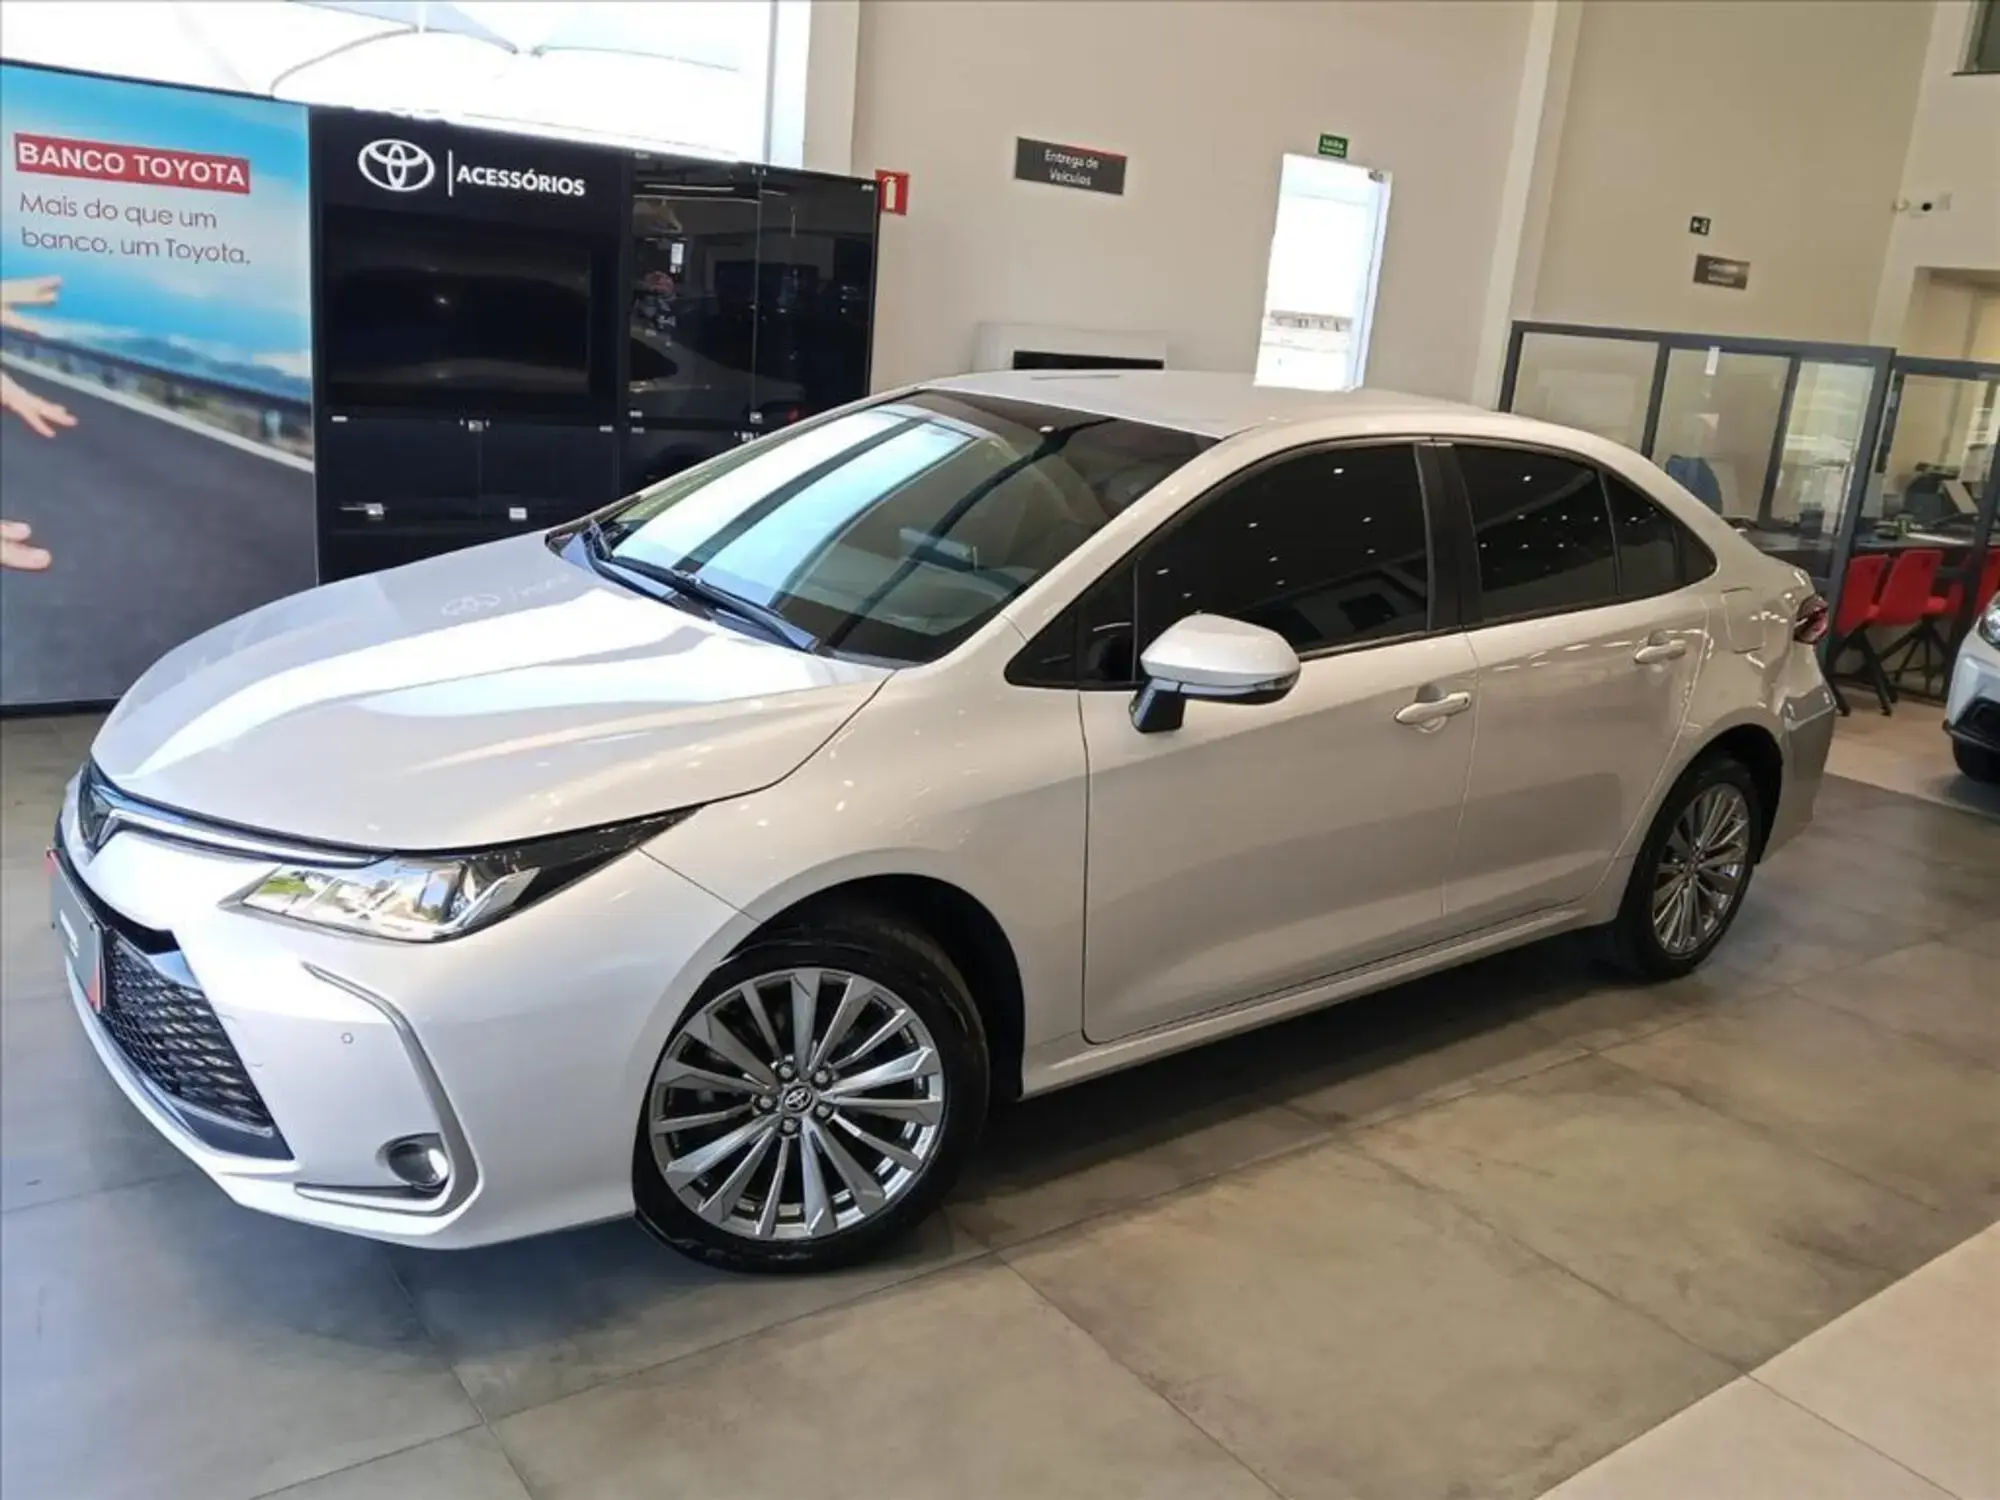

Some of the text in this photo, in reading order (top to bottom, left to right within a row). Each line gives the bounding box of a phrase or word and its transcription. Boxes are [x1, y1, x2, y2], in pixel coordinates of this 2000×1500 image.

[18, 142, 245, 187] BANCO TOYOTA
[1044, 149, 1099, 170] Entrega de
[456, 165, 586, 197] ACESSÓRIOS
[19, 192, 217, 228] Mais do que um
[21, 227, 251, 265] banco, um Toyota.
